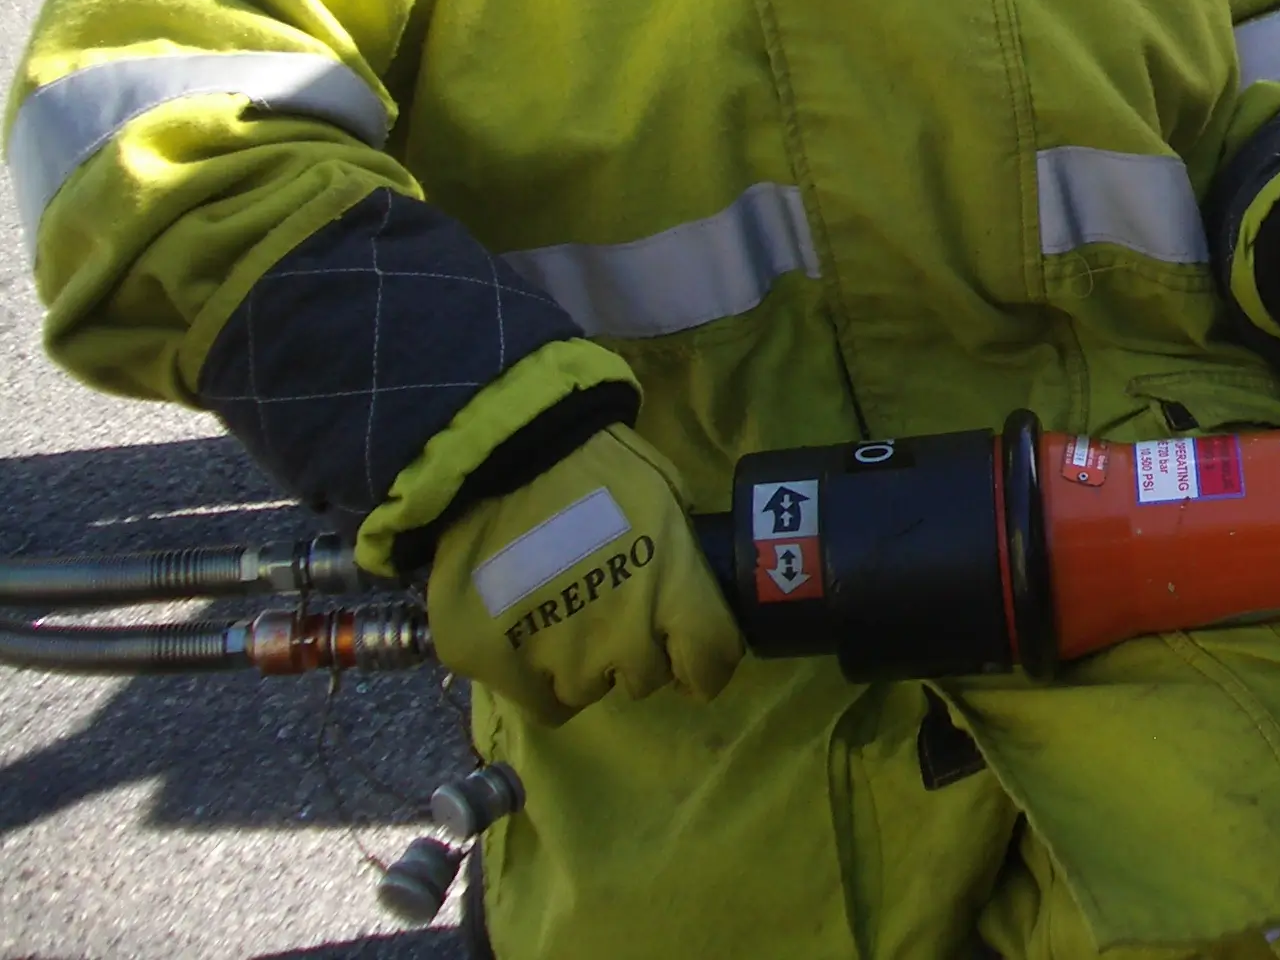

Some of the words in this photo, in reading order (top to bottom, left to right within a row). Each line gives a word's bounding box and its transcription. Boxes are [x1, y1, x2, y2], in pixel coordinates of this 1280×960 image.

[1142, 473, 1155, 492] PSI
[1159, 458, 1170, 474] bar
[1175, 442, 1190, 492] OPERATING
[503, 535, 656, 651] FIREPRO
